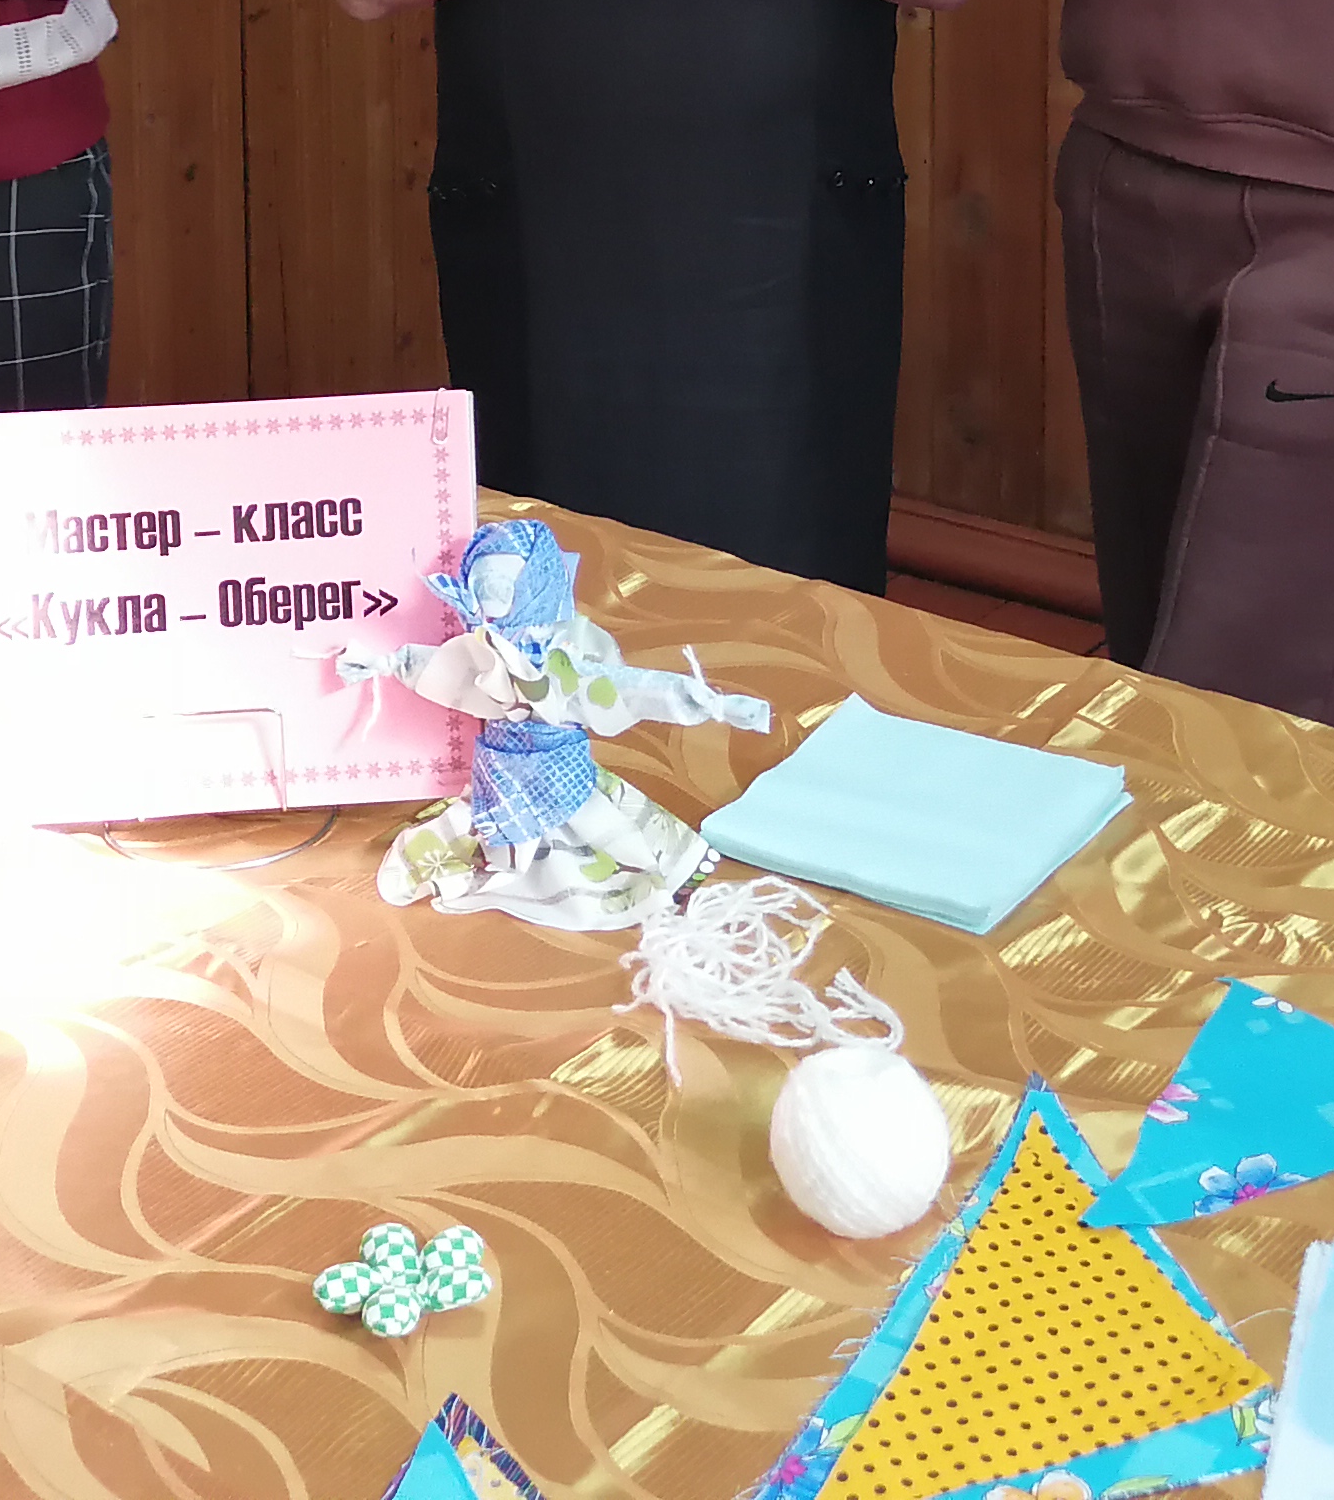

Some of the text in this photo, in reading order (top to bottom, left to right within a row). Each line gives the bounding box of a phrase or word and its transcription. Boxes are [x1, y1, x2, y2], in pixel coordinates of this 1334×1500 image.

[26, 508, 181, 556] Мастер
[233, 498, 362, 544] класс
[219, 577, 399, 630] Оберег»
